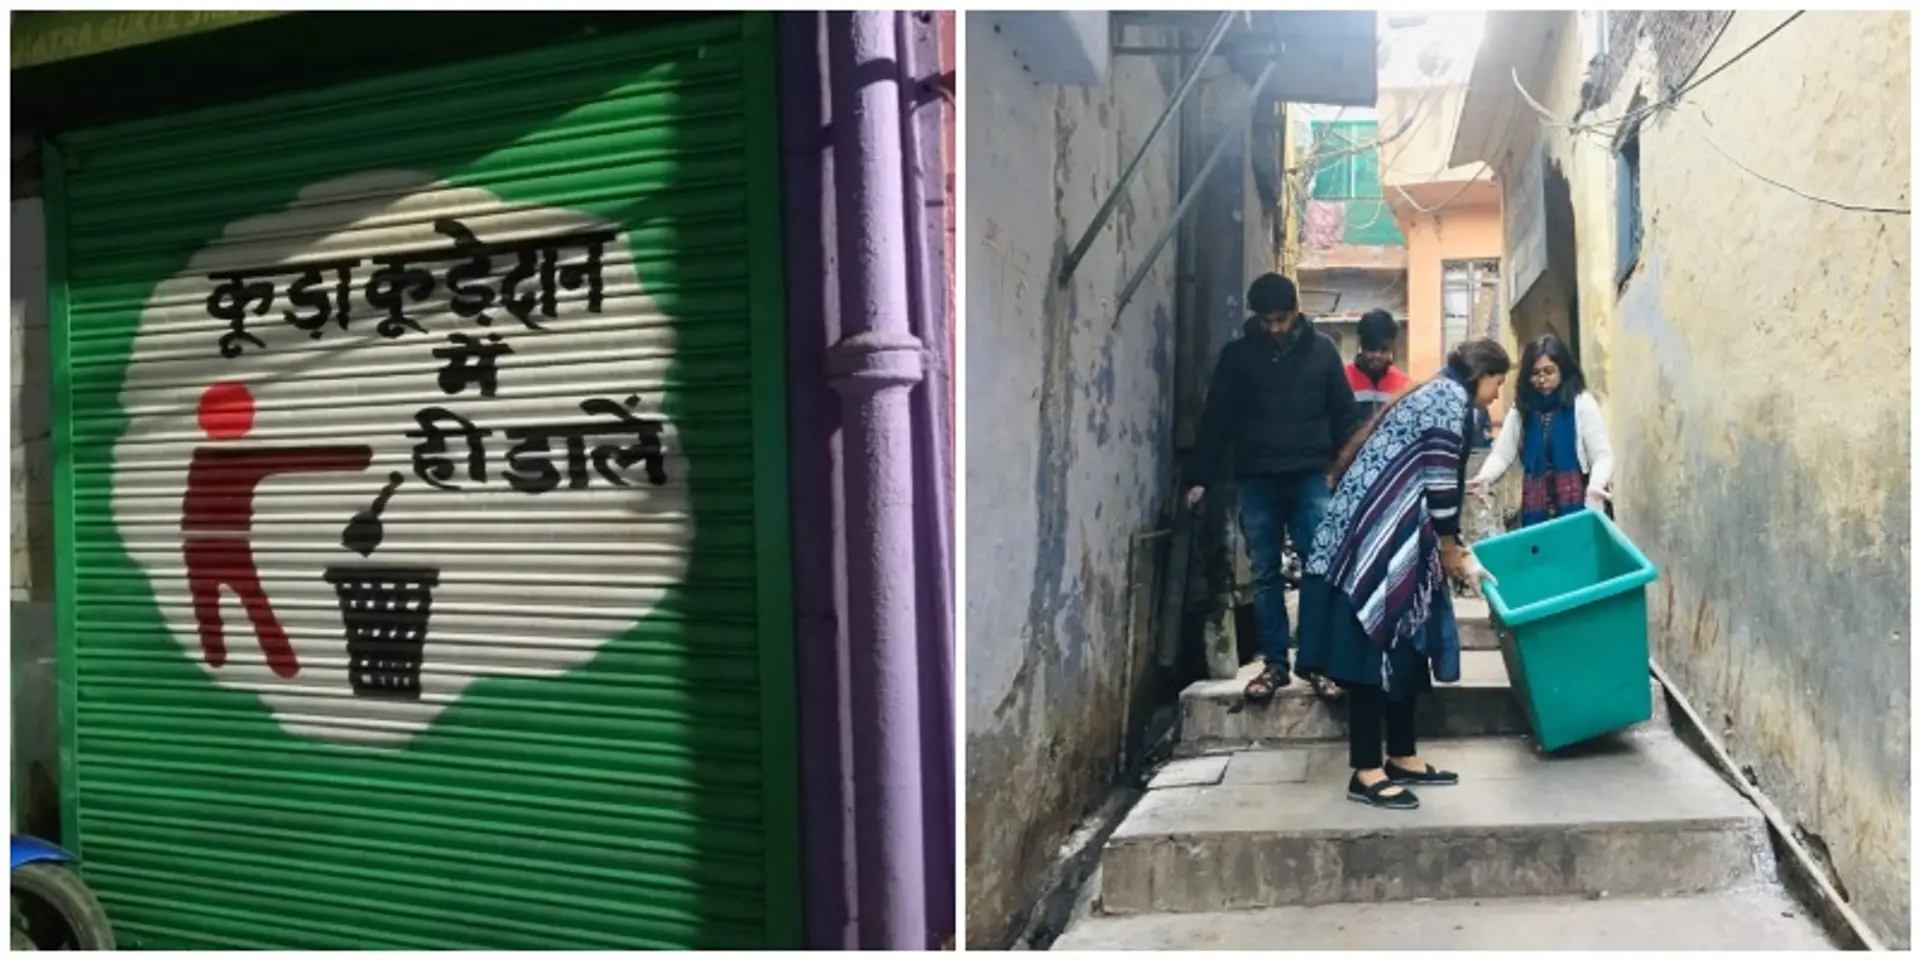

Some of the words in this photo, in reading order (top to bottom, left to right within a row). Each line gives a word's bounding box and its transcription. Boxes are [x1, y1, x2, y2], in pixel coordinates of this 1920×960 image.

[207, 258, 360, 357] कूड़ा
[366, 218, 616, 337] कूड़ेदान
[432, 333, 515, 397] में
[406, 407, 493, 491] ही
[503, 394, 668, 493] डालें
